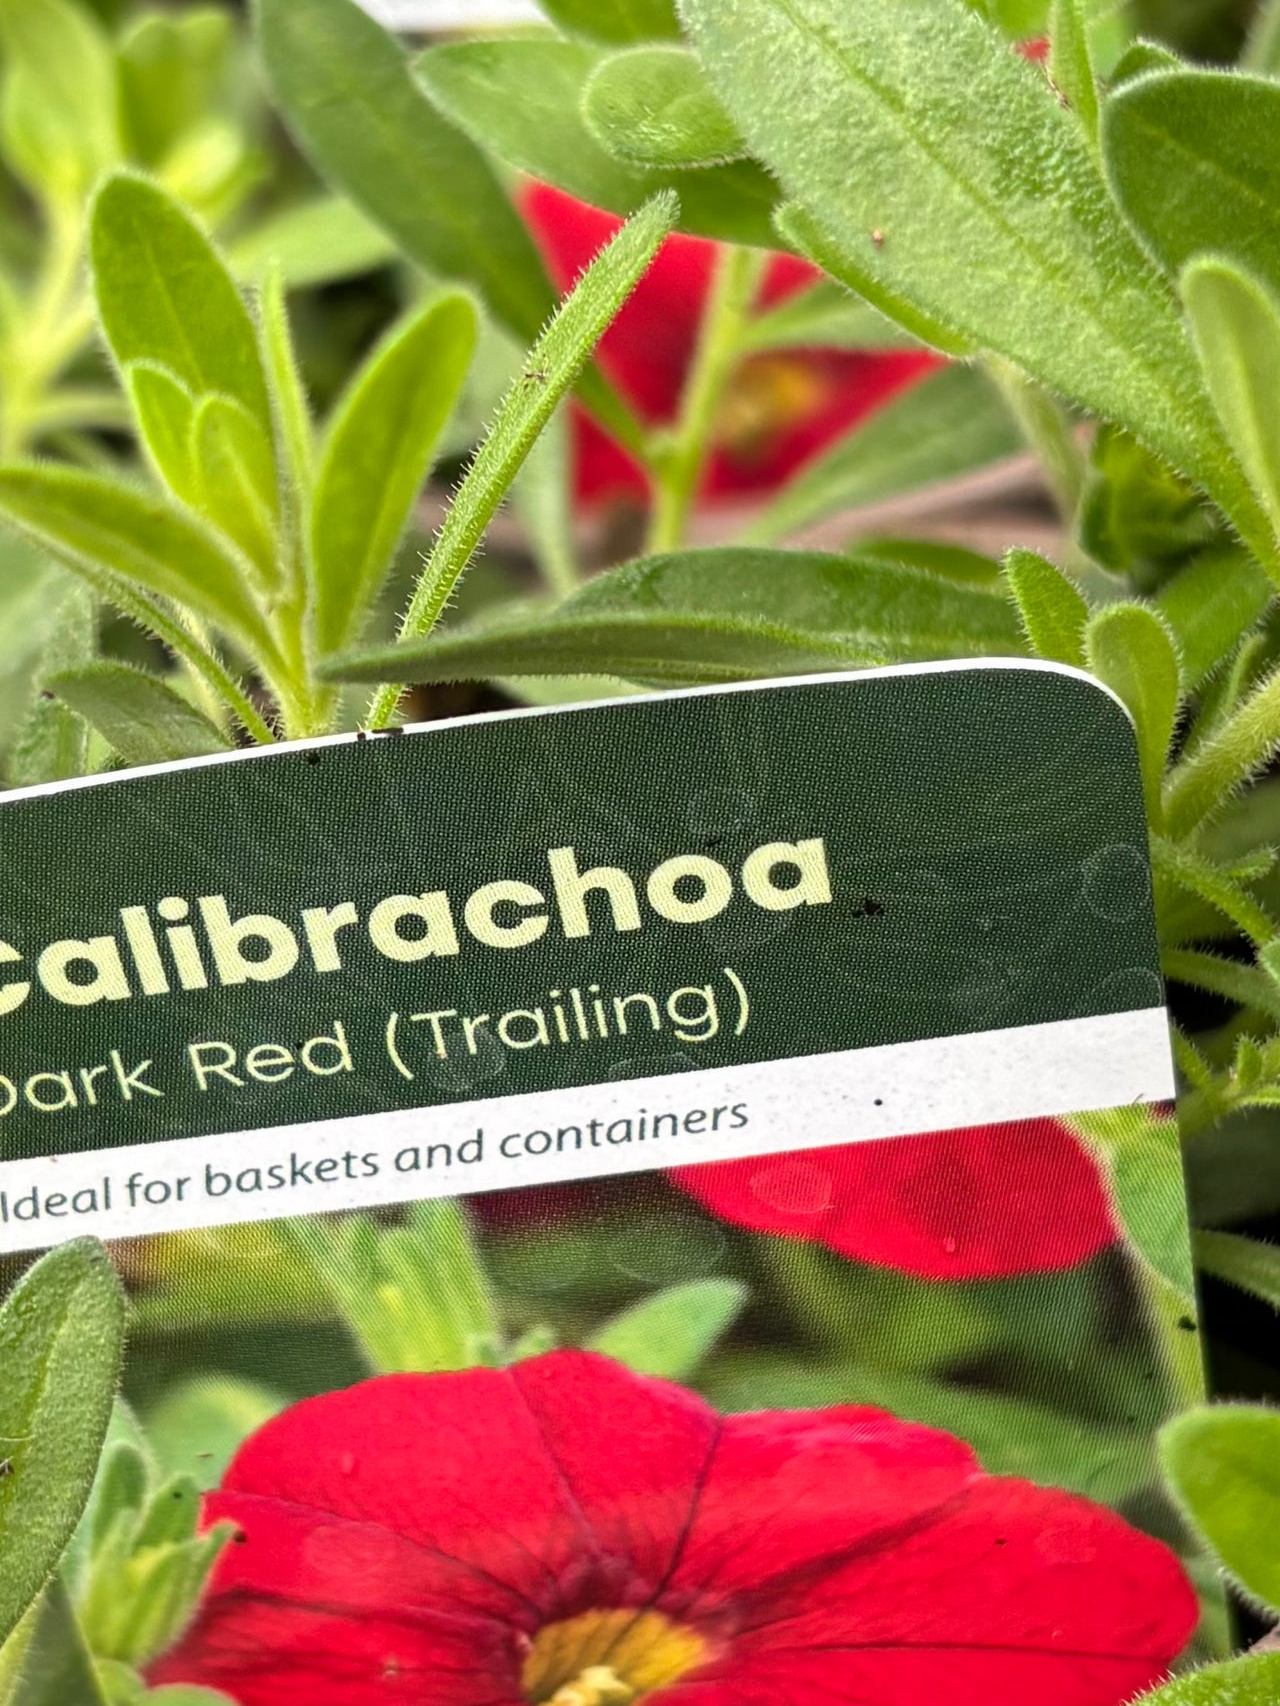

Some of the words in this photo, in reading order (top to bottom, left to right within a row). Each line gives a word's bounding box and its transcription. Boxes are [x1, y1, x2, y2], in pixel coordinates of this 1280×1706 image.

[186, 1022, 354, 1090] Red
[384, 968, 750, 1080] (Trailing)
[124, 1172, 192, 1207] for
[202, 1150, 380, 1197] baskets
[393, 1128, 486, 1172] and
[498, 1101, 750, 1159] containers
